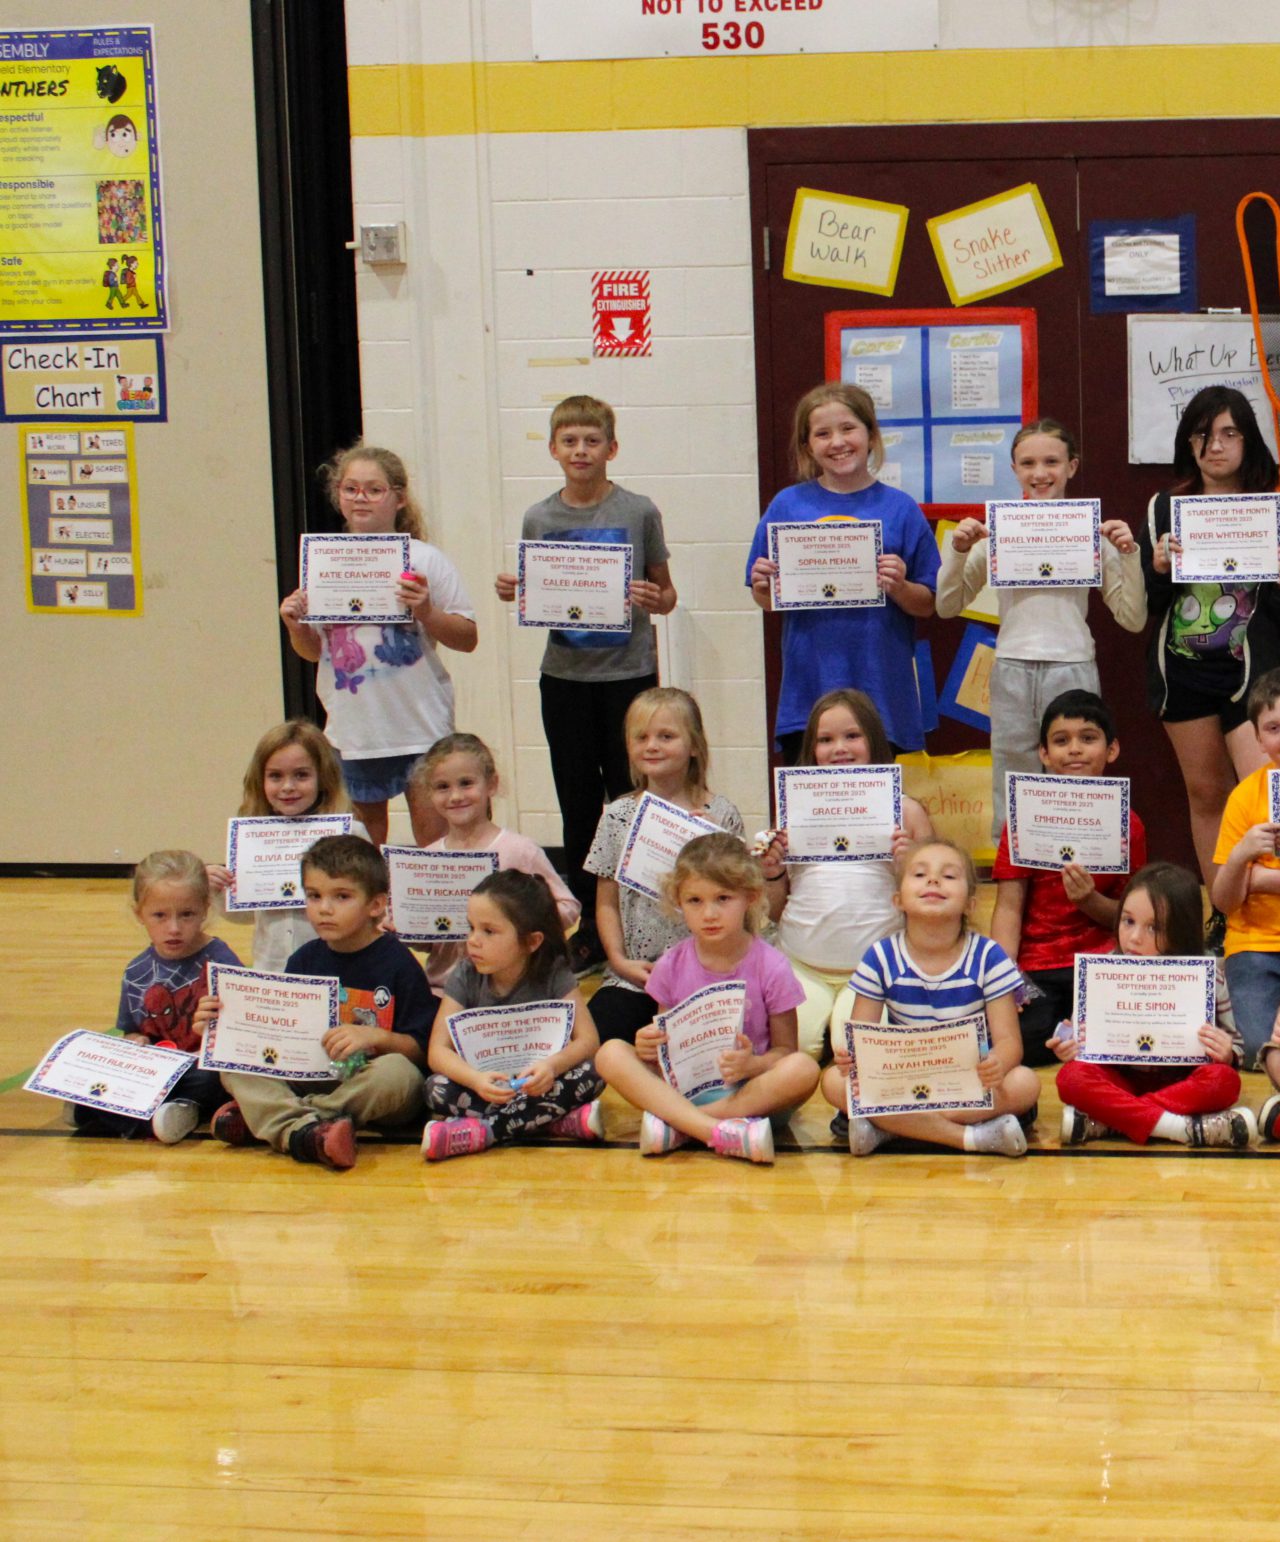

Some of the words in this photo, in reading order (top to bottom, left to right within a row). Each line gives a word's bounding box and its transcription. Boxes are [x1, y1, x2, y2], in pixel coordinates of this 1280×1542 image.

[642, 0, 682, 15] NOT
[698, 0, 723, 14] TO
[735, 0, 823, 12] EXCEED
[702, 21, 765, 50] 530
[93, 47, 143, 56] EXPECTATIONS
[18, 65, 70, 74] Elementary
[818, 209, 876, 242] Bear
[954, 227, 1017, 264] Snake
[2, 257, 22, 266] Safe
[973, 249, 1031, 280] Slither
[603, 283, 639, 296] FIRE
[598, 300, 645, 310] EXTINGUISHER
[1149, 344, 1205, 376] What
[1210, 344, 1237, 368] Up
[36, 386, 102, 408] Chart
[573, 580, 607, 588] ABRAMS
[1023, 789, 1057, 797] STUDENT
[1078, 817, 1101, 825] ESSA
[225, 983, 259, 993] STUDENT
[275, 990, 289, 998] THE
[291, 992, 321, 1000] MONTH
[245, 995, 280, 1005] SEPTEMBER
[1117, 1002, 1142, 1010] ELLIE
[1146, 1002, 1176, 1011] SIMON
[245, 1013, 268, 1023] BEAU
[271, 1017, 298, 1027] WOLF
[680, 1028, 716, 1050] REAGAN
[719, 1026, 737, 1035] DEL
[475, 1044, 518, 1060] VIOLETTE
[77, 1051, 107, 1062] MARTI
[108, 1058, 157, 1076] RULIFFSON
[883, 1061, 920, 1070] ALIYAH
[923, 1057, 953, 1067] MUNIZ
